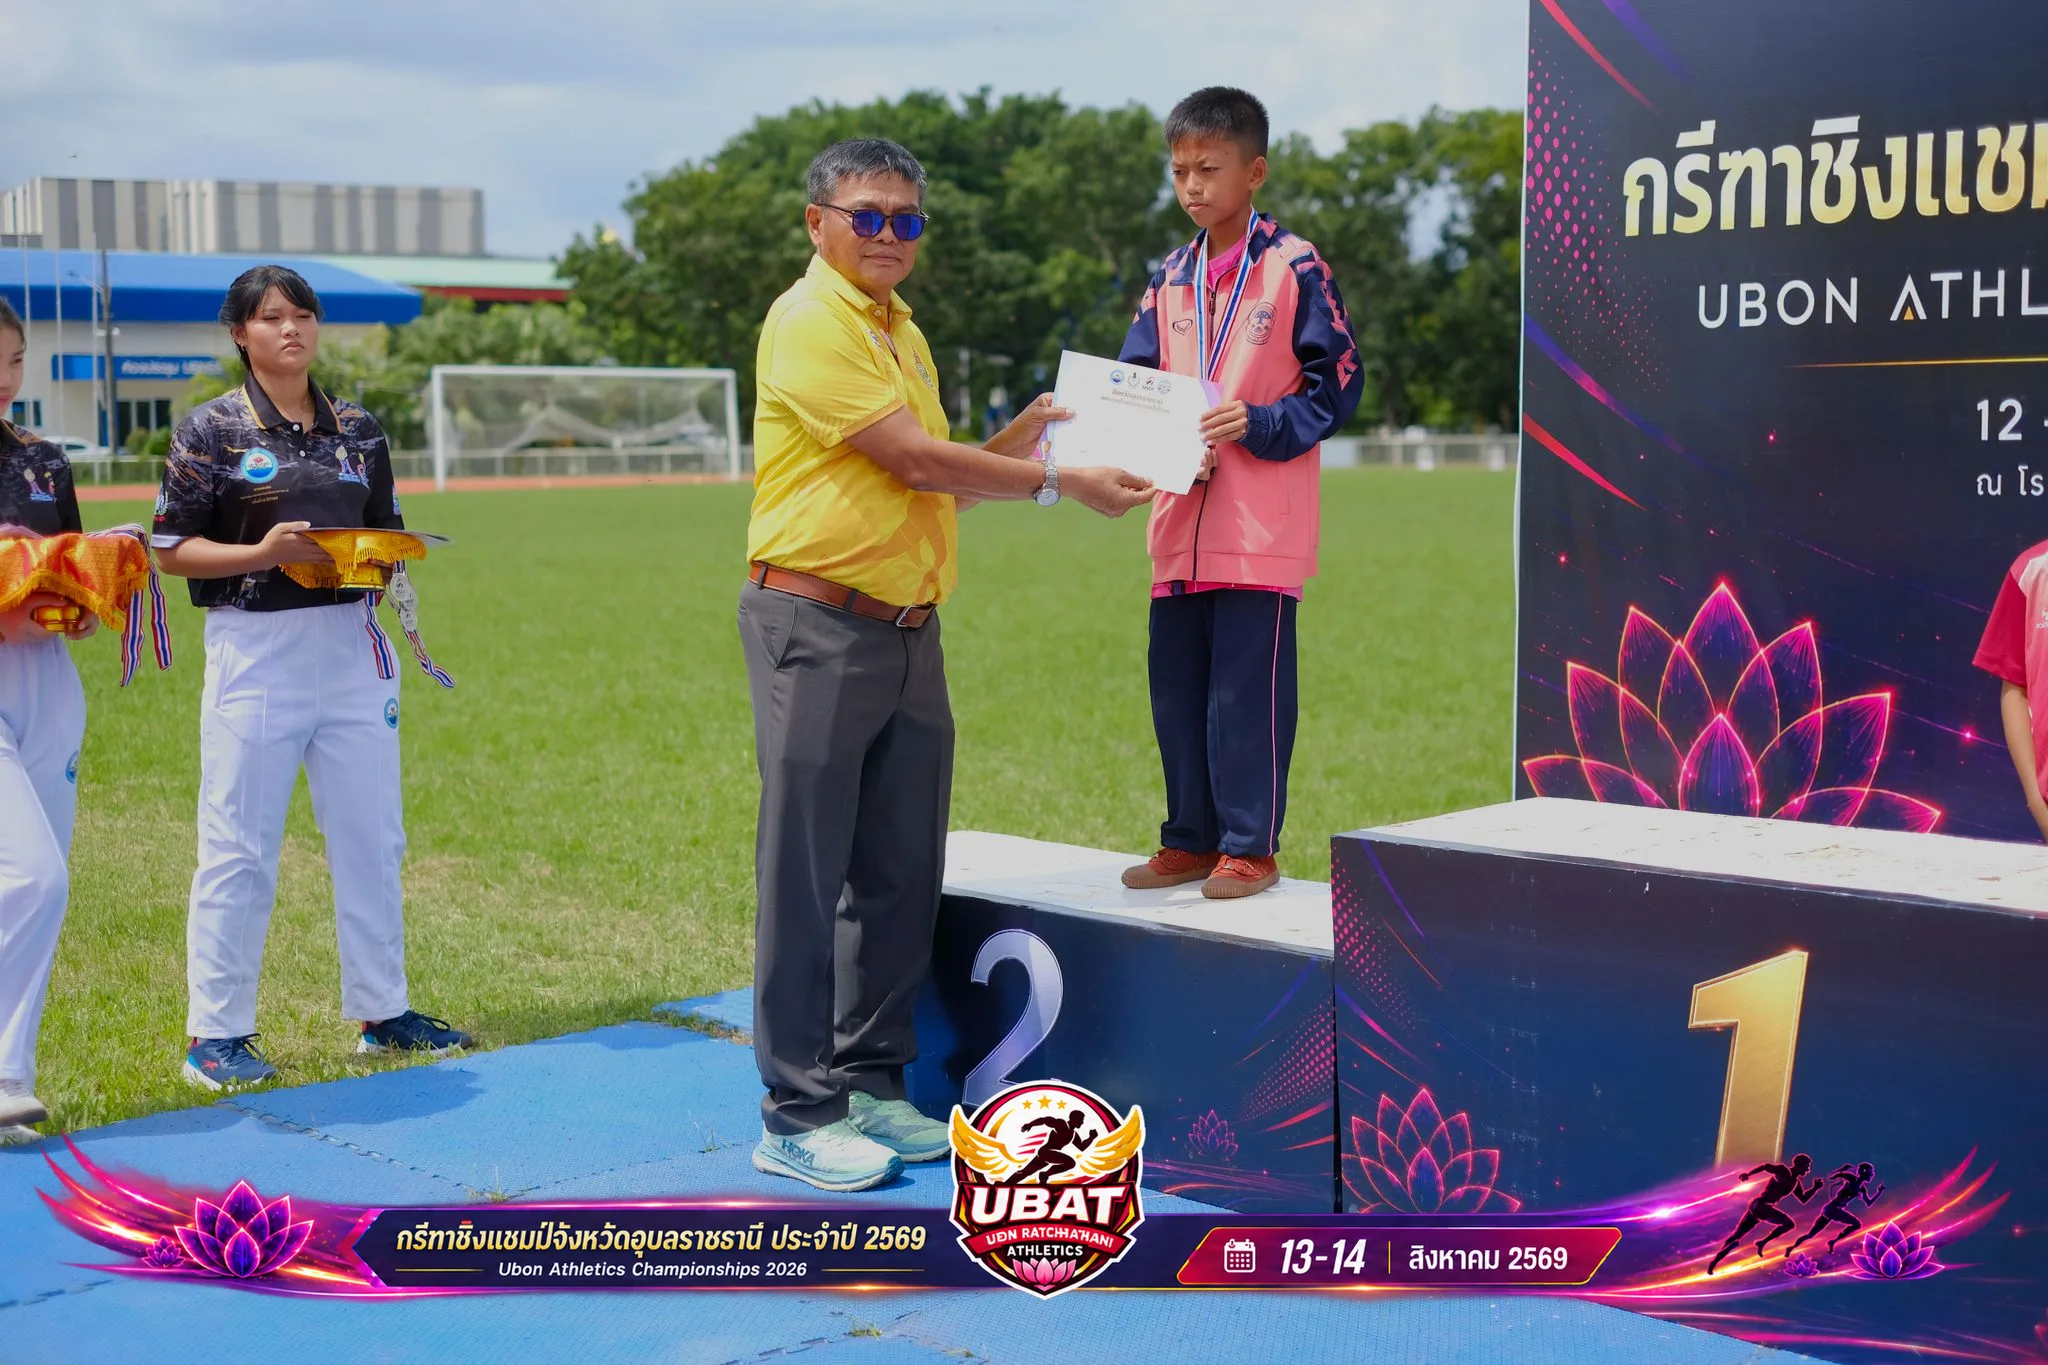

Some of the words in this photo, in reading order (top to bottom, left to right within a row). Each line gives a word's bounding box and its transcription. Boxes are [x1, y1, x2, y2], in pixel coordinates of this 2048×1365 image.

[1699, 277, 1858, 328] UBON
[1976, 398, 2023, 441] 12
[1976, 473, 2002, 497] ณ
[962, 929, 1064, 1108] 2
[1688, 949, 1809, 1173] 1
[781, 1137, 816, 1168] HOKA
